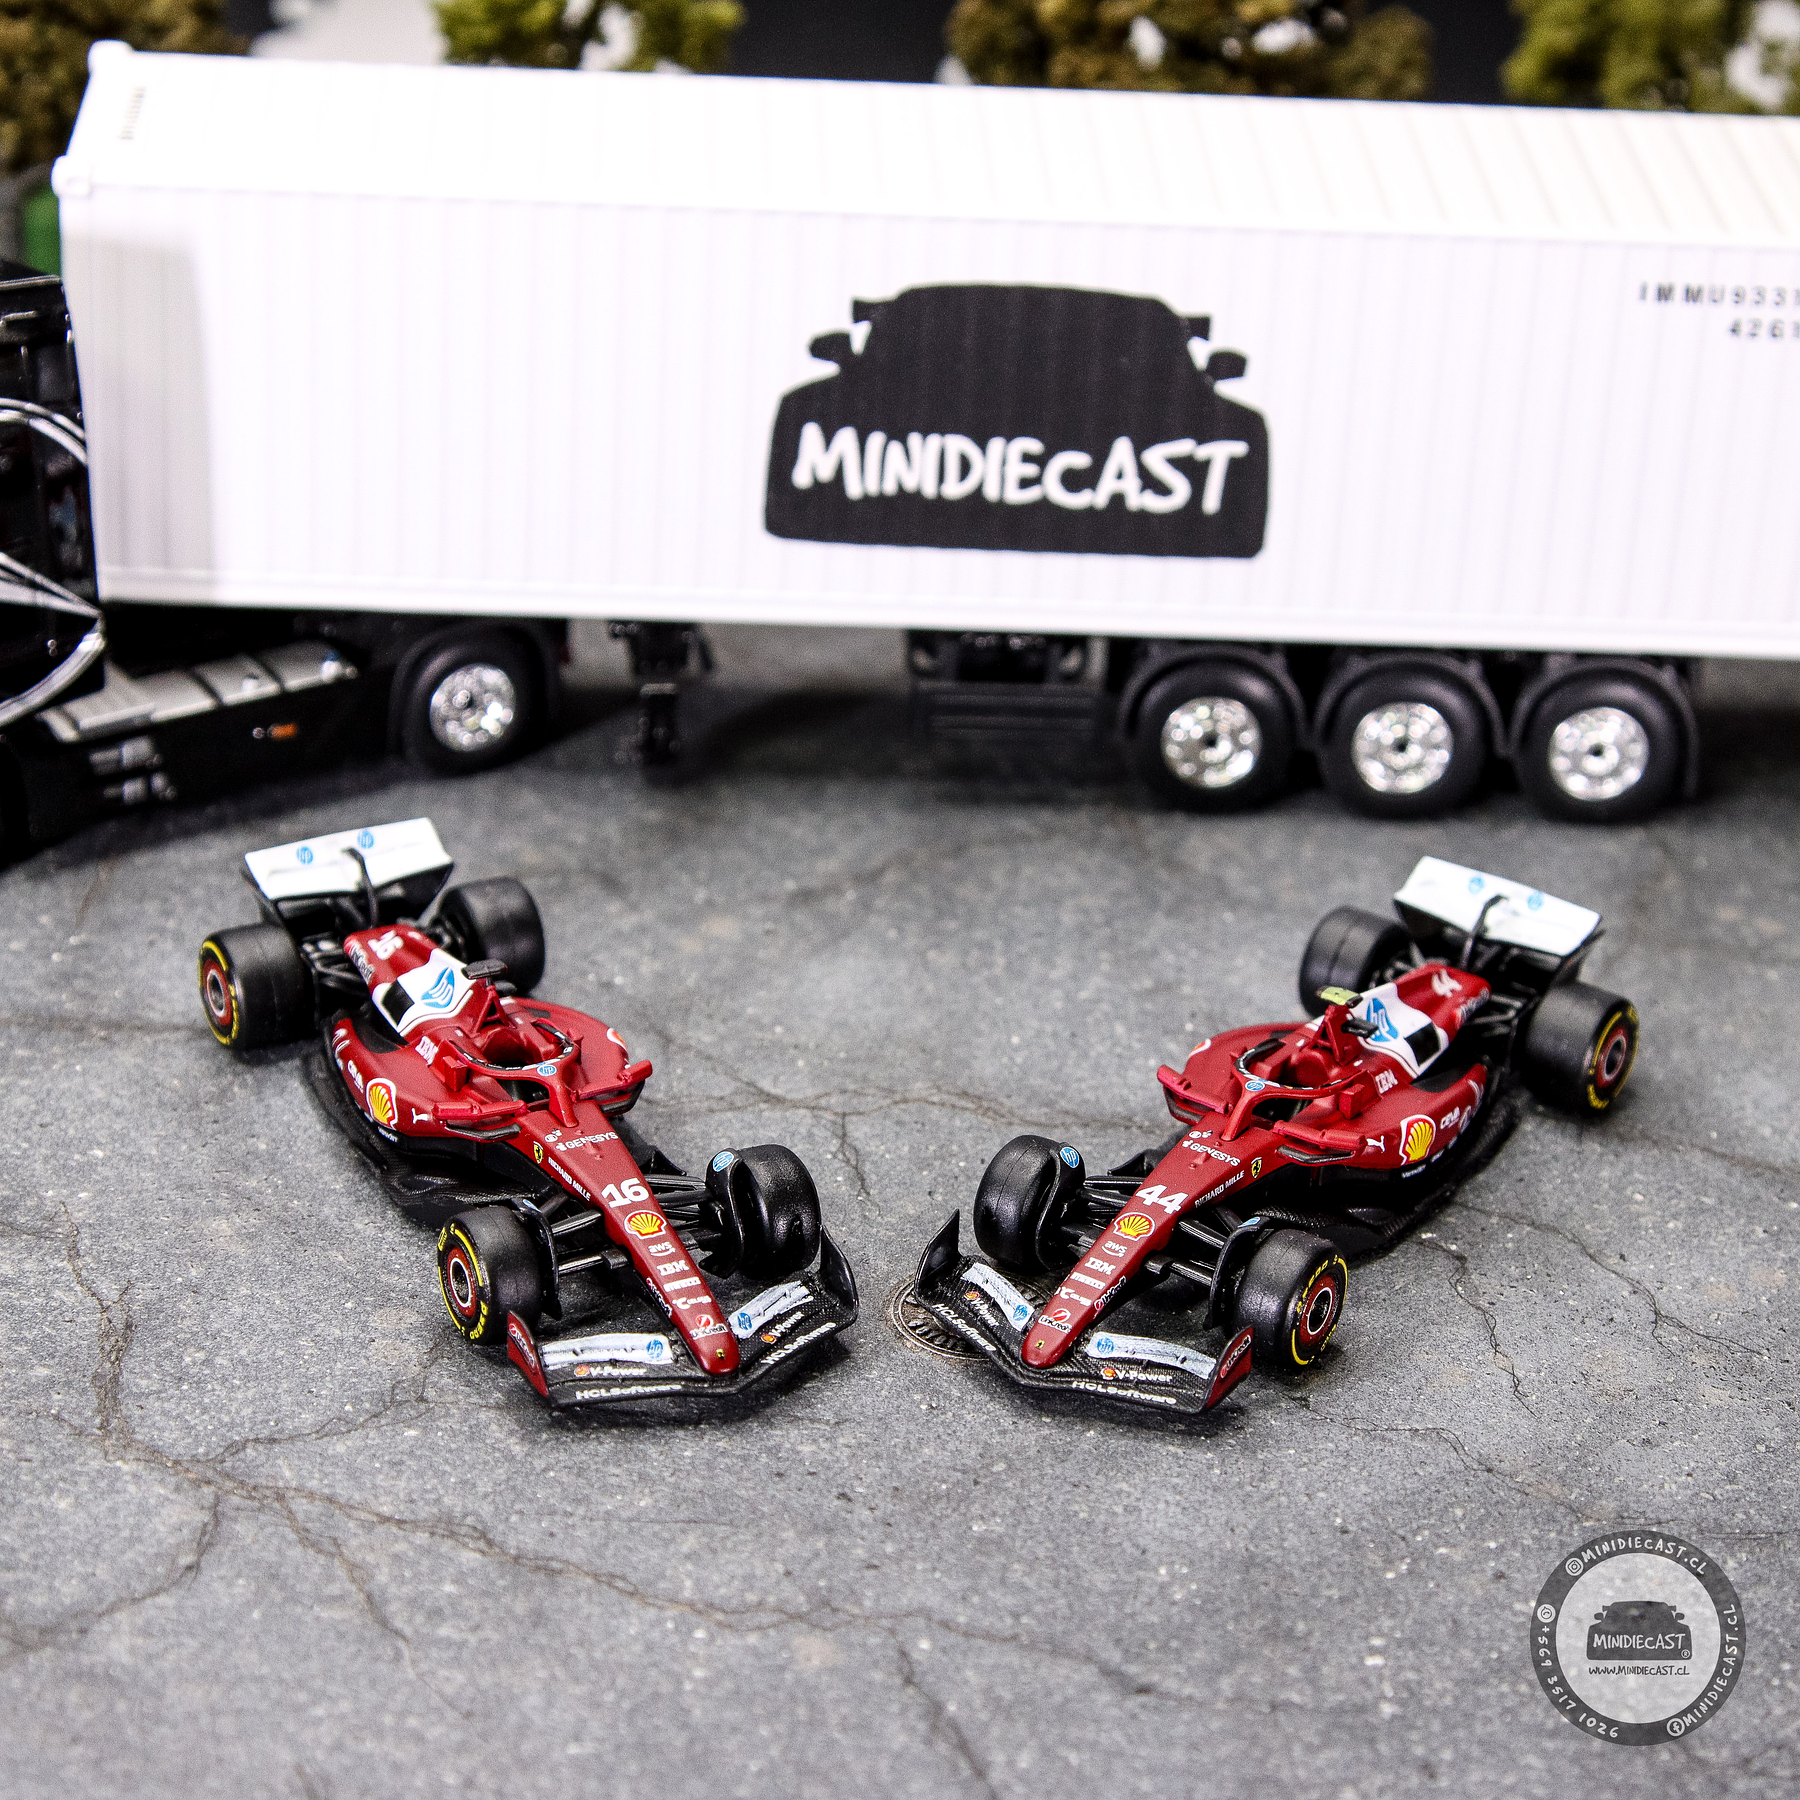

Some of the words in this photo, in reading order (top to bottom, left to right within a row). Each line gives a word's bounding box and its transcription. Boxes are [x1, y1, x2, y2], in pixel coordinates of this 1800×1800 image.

[792, 421, 1250, 516] MINIDIECAST
[565, 1131, 619, 1150] GENESYS
[1060, 1147, 1079, 1168] hp
[1189, 1143, 1241, 1167] GENESYS
[601, 1177, 649, 1209] 16
[1194, 1183, 1225, 1209] RICHARD
[1225, 1170, 1245, 1189] MILLE
[1135, 1184, 1189, 1215] 44
[648, 1241, 673, 1253] aws
[1104, 1240, 1128, 1254] aws
[656, 1260, 690, 1277] IBM
[1084, 1257, 1117, 1276] IBM
[769, 1311, 804, 1337] V-Power
[646, 1340, 664, 1359] hp
[589, 1366, 648, 1377] V-Power
[1116, 1370, 1173, 1383] V-Power
[575, 1384, 682, 1400] HCLSoftware
[1072, 1381, 1177, 1405] HCLSoftware
